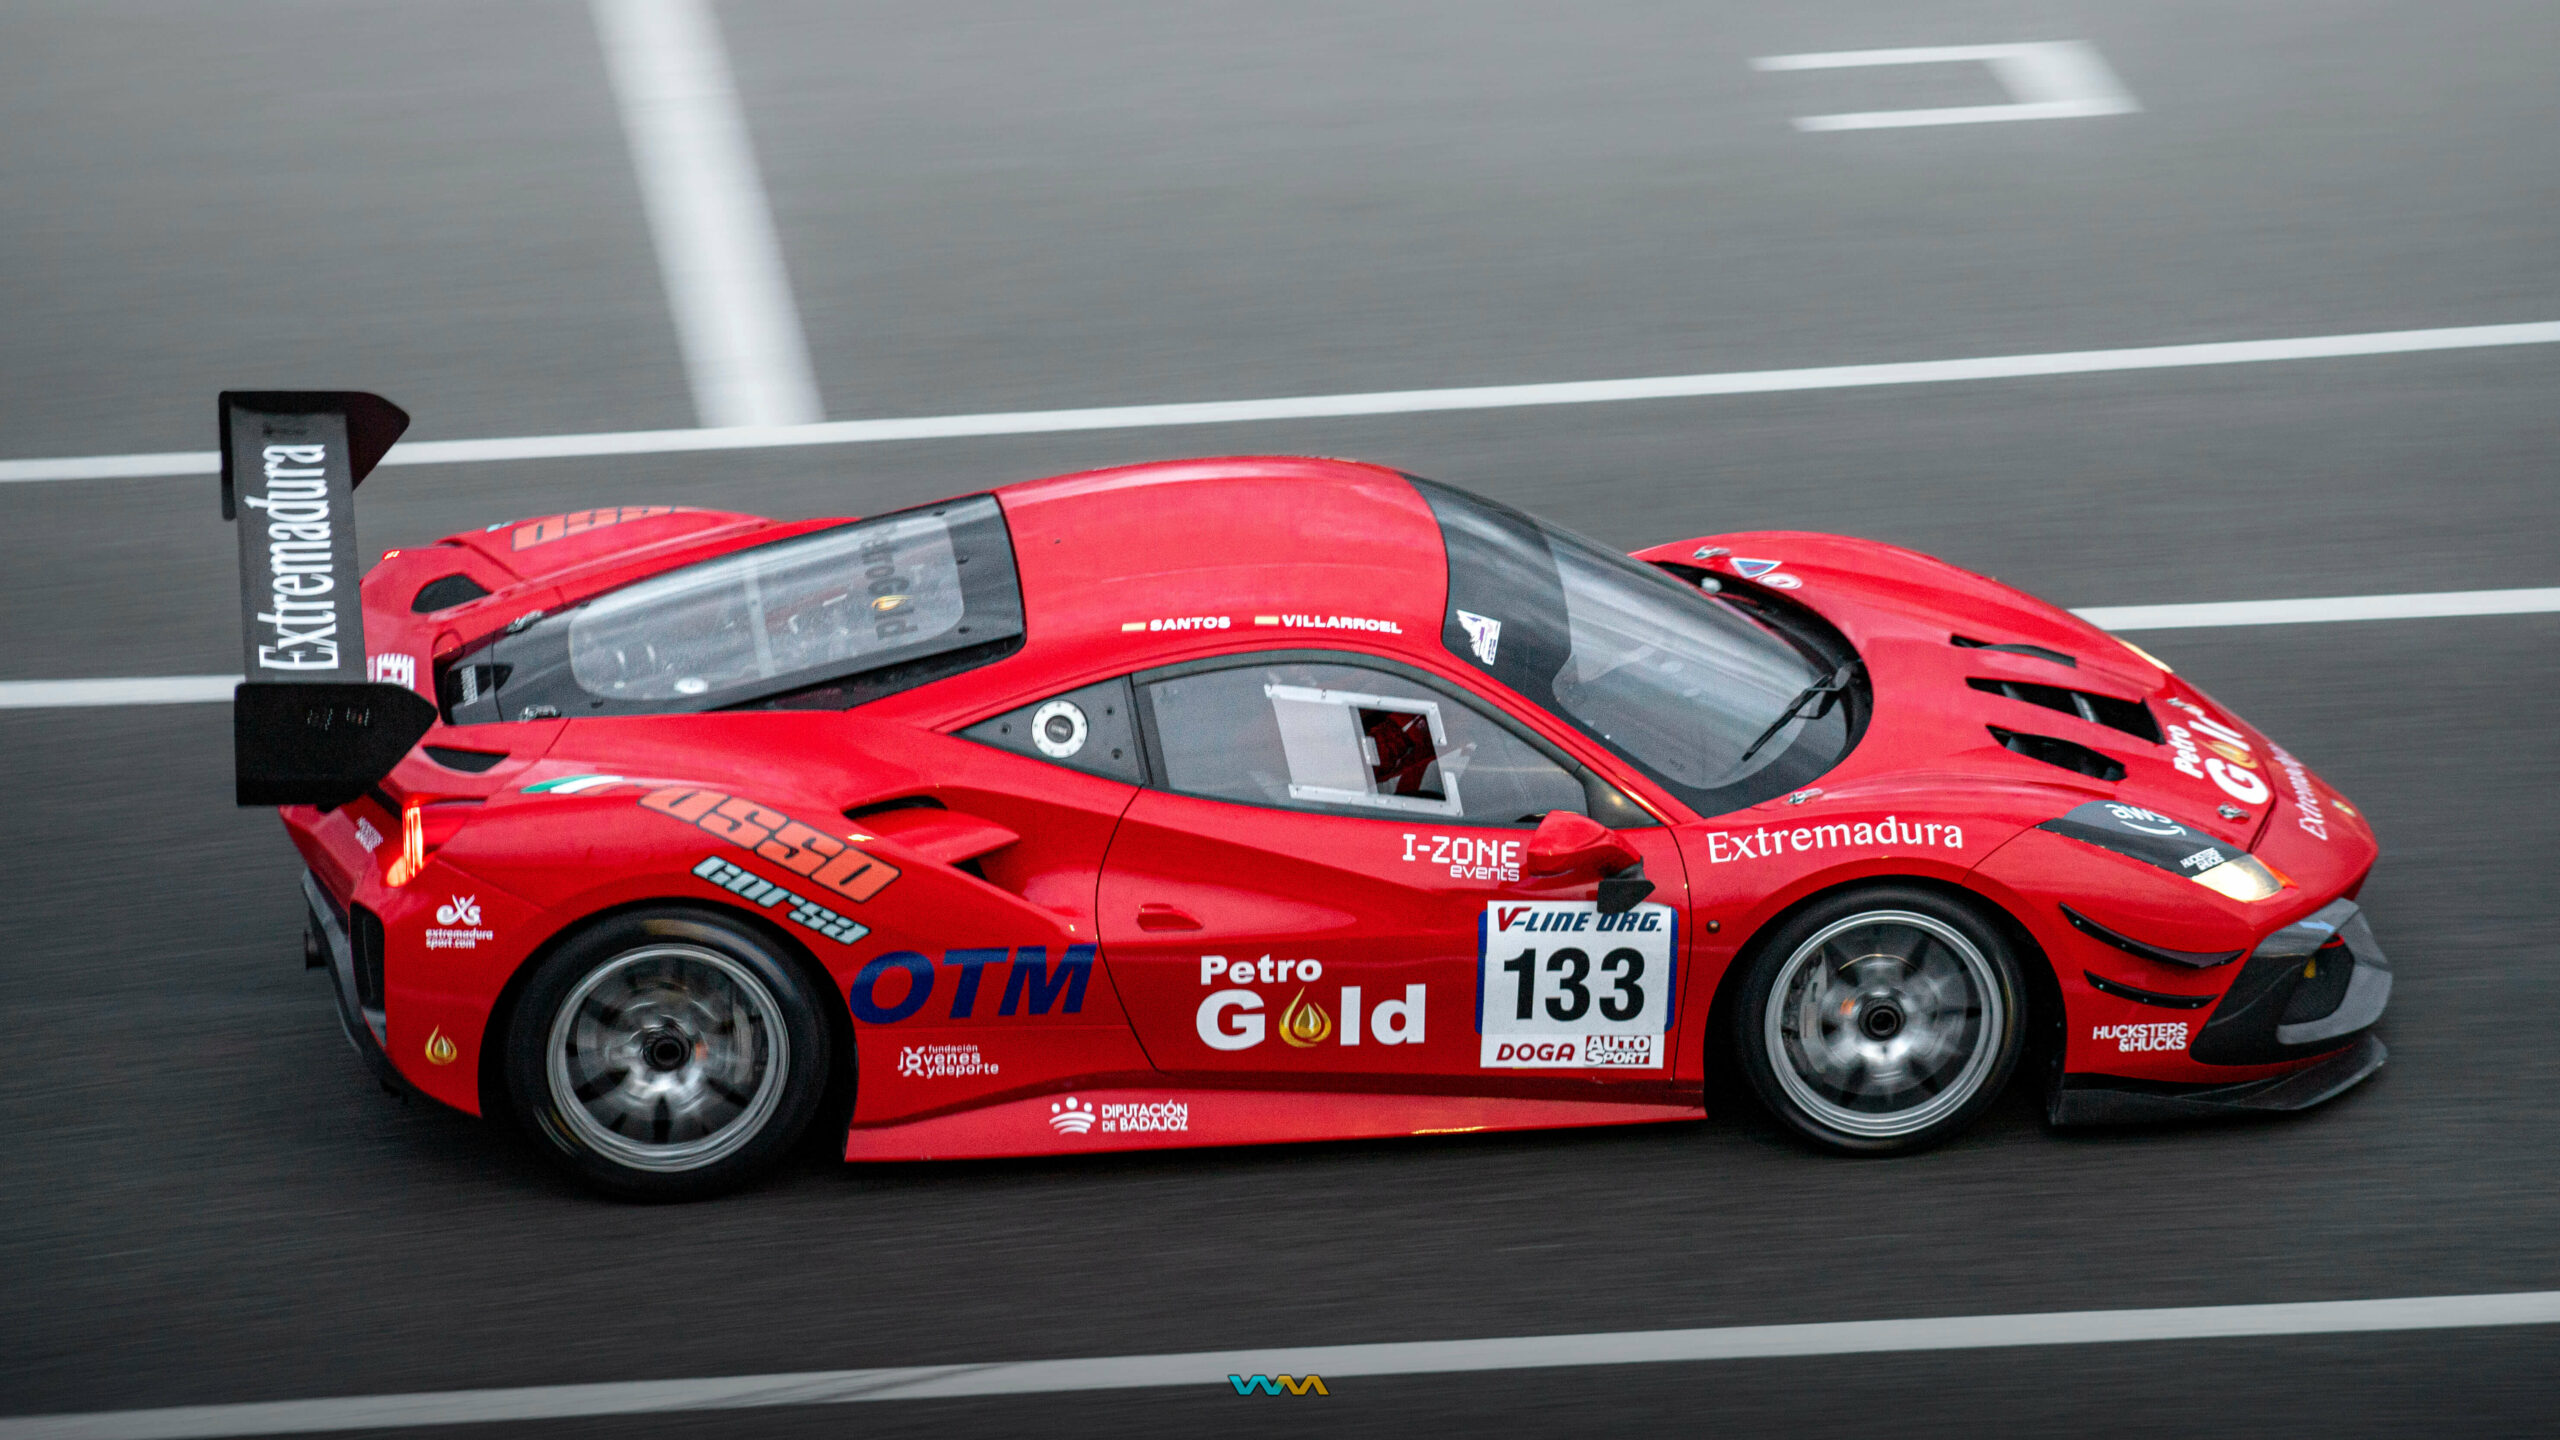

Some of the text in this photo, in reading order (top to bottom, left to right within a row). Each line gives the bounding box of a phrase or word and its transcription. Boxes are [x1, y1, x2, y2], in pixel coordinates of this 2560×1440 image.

[245, 443, 340, 671] Extremadura
[1150, 616, 1231, 631] SANTOS
[1282, 614, 1403, 634] VILLARROEL
[2167, 724, 2204, 779] Petro
[2104, 803, 2173, 824] aws
[1707, 815, 1964, 864] Extremadura
[1402, 833, 1520, 868] I-ZONE
[1450, 865, 1520, 882] events
[1498, 906, 1662, 932] V-LINE ORG.
[425, 928, 493, 941] extremadura
[1200, 954, 1322, 985] Petro
[849, 943, 1098, 1024] OTM
[1503, 947, 1646, 1024] 133
[2092, 1022, 2188, 1040] HUCKSTERS
[1496, 1043, 1575, 1062] DOGA
[1586, 1035, 1650, 1051] AUTO
[2118, 1036, 2187, 1052] &HUCKS
[1586, 1050, 1650, 1066] SPORT
[1101, 1099, 1188, 1119] DIPUTACIÓN
[1102, 1116, 1188, 1132] DE BADAJOZ
